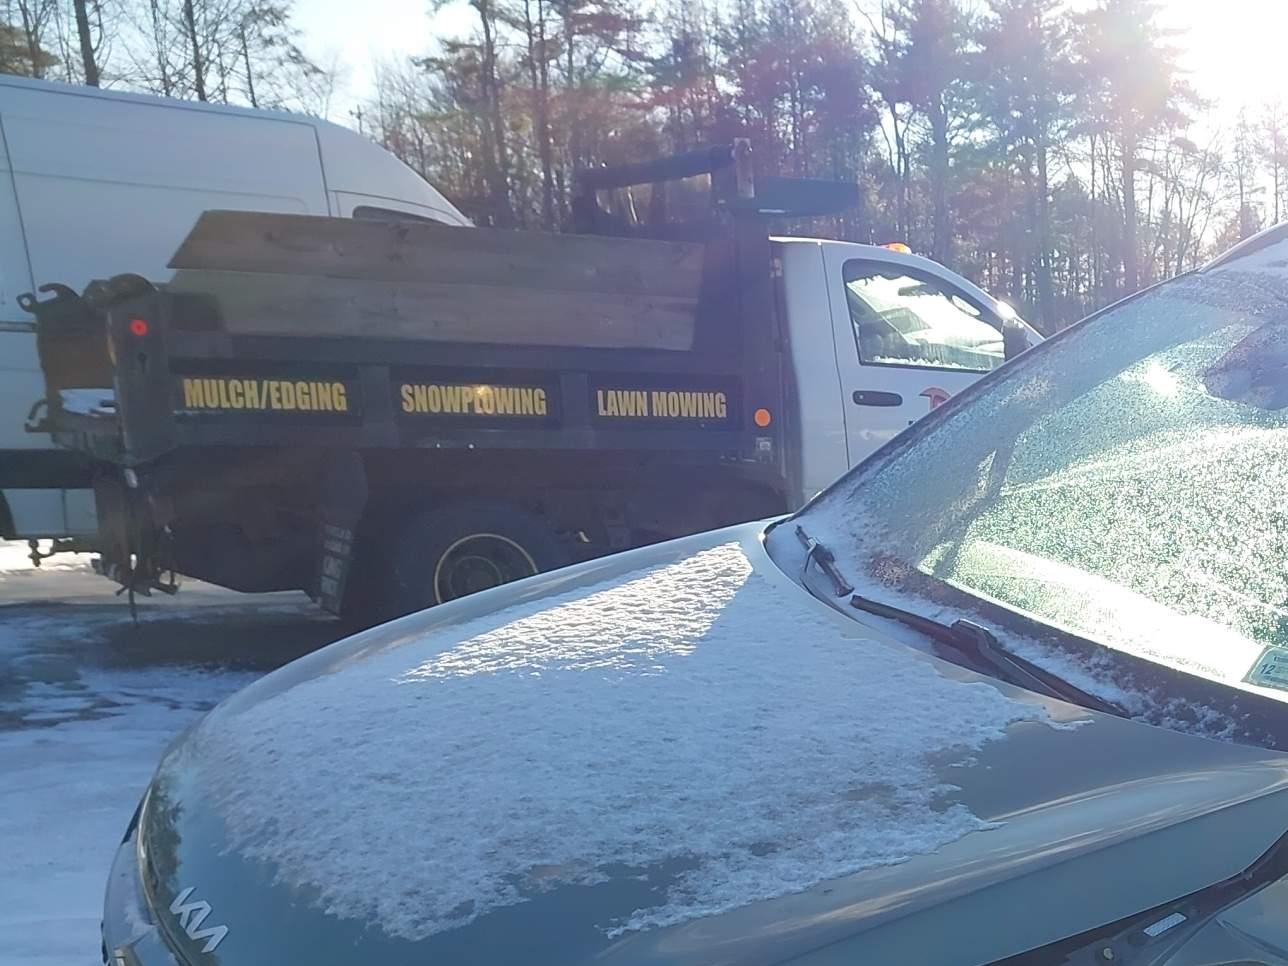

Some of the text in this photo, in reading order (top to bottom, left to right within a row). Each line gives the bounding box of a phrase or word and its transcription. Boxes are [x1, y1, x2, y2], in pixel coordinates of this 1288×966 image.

[183, 379, 347, 411] MULCH/EDGING
[400, 384, 547, 415] SNOWPLOWING
[597, 390, 727, 418] LAWN MOWING
[1260, 663, 1276, 675] 12
[169, 887, 229, 953] KIA
